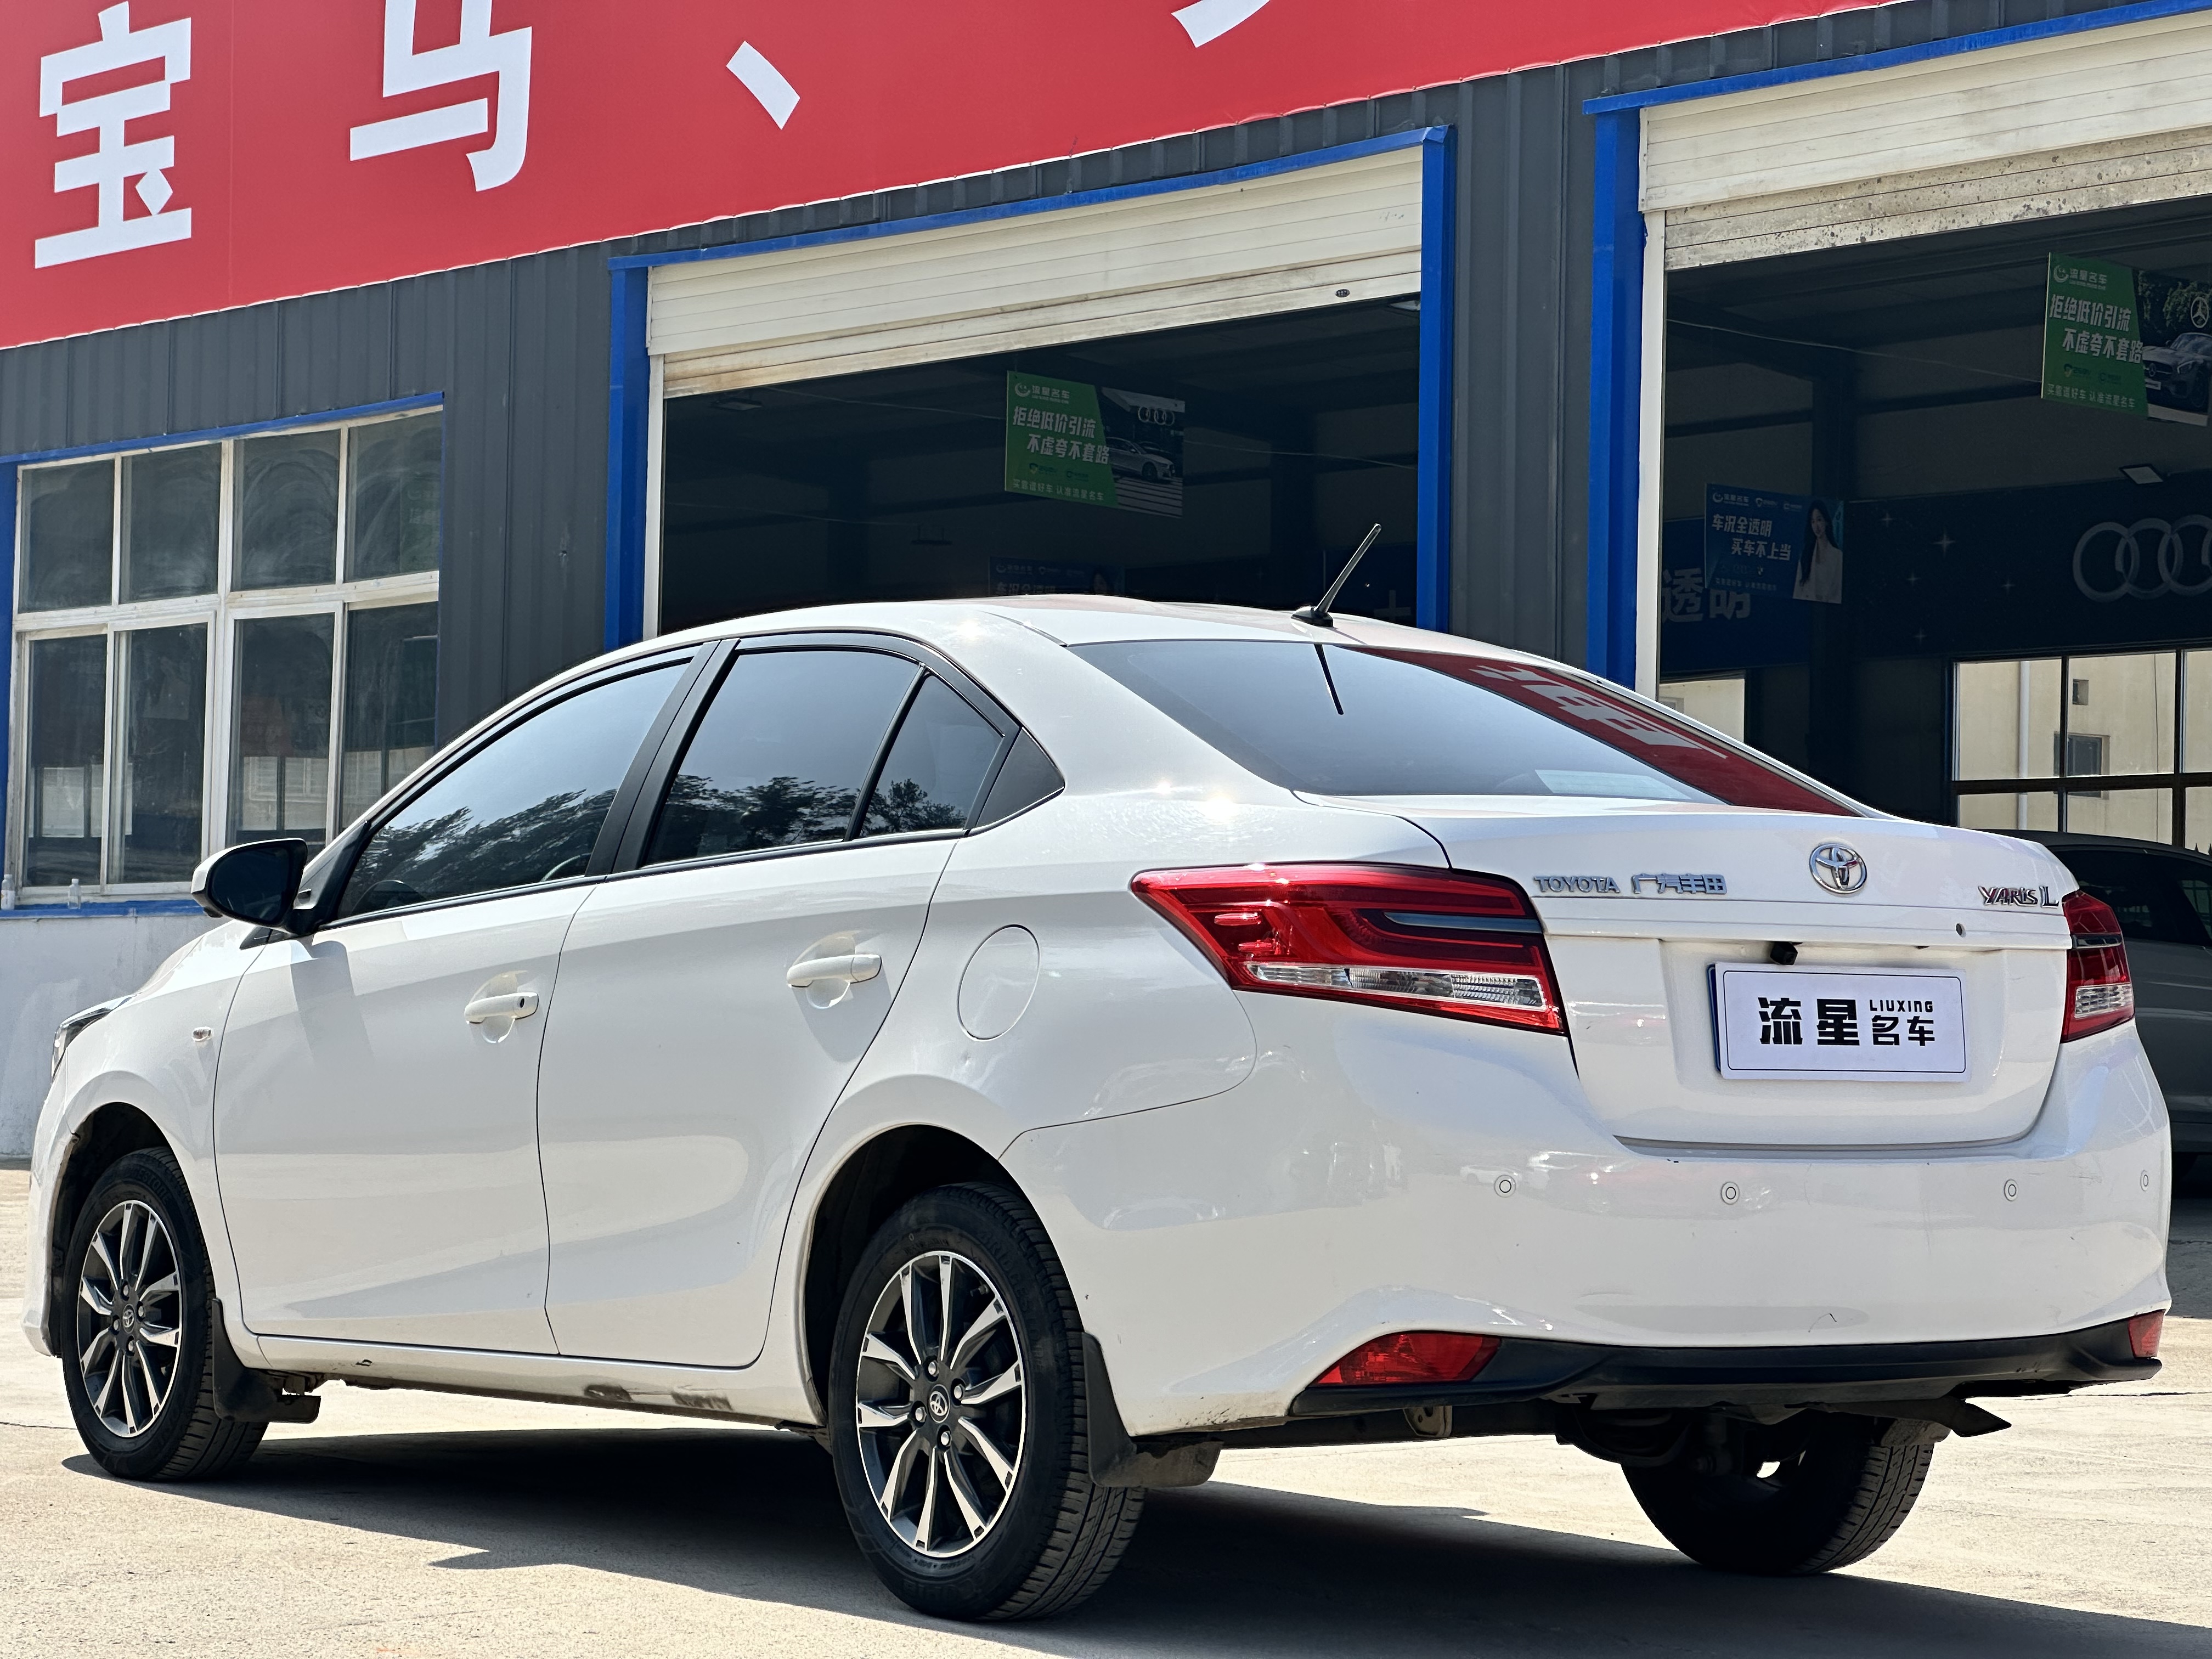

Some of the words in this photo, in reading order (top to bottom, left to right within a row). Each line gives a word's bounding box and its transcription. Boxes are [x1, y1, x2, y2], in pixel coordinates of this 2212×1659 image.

[34, 0, 1274, 269] 宝马、
[2049, 294, 2132, 332] 拒绝低价引流
[2062, 328, 2143, 364] 不虚夸不套路
[1013, 406, 1097, 439] 拒绝低价引流
[1026, 433, 1110, 465] 不虚夸不套路
[1711, 514, 1773, 538] 车况全透明
[1731, 538, 1791, 561] 买车不上当
[1533, 874, 1620, 894] TOYOTA
[1630, 873, 1726, 895] 广汽丰田
[2039, 885, 2059, 909] L
